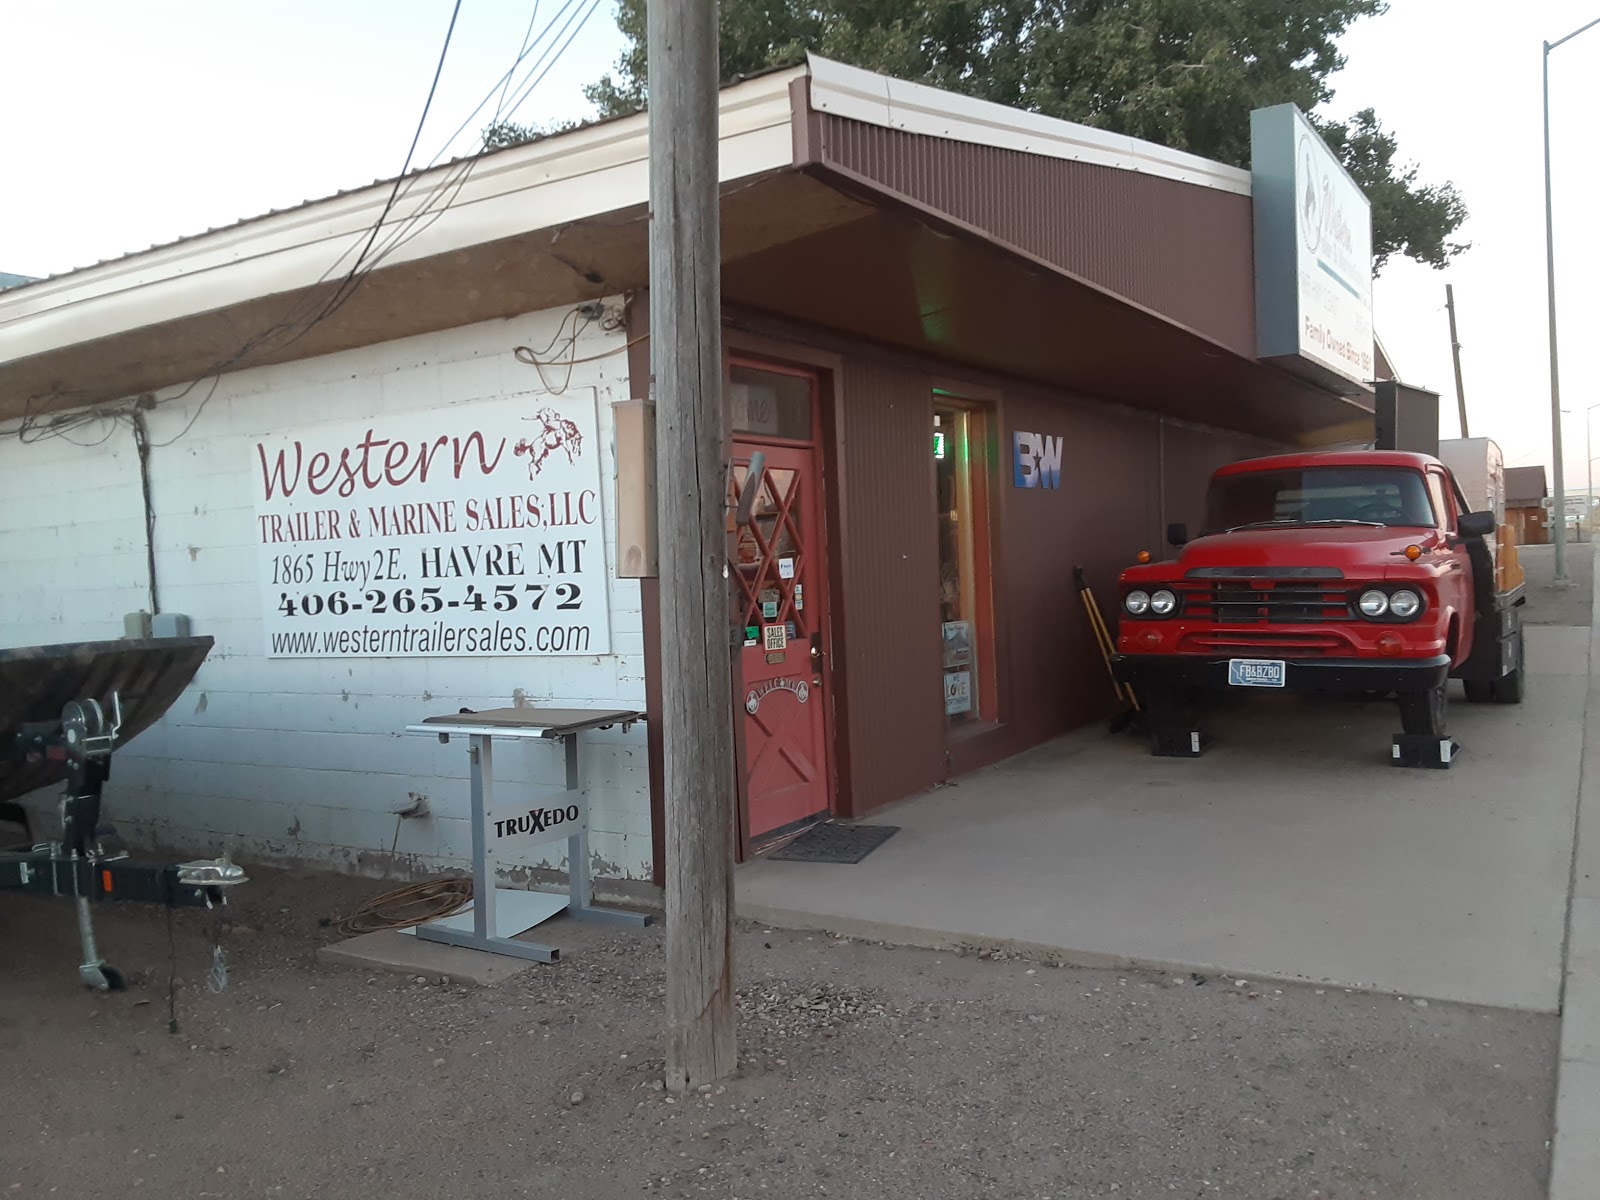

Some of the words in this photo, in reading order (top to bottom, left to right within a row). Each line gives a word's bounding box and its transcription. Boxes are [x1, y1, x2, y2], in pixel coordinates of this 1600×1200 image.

[256, 428, 507, 502] Western
[257, 508, 342, 544] TRAILER
[348, 508, 361, 538] &
[368, 499, 458, 538] MARINE
[271, 553, 315, 585] 1865
[420, 541, 525, 579] HAVRE
[536, 539, 587, 575] MT
[277, 582, 584, 618] 406-265-4572
[271, 619, 590, 655] www.westerntrailersales.com
[767, 627, 784, 638] SALES
[767, 637, 785, 649] OFFICE
[494, 805, 579, 838] TRUXEDO
